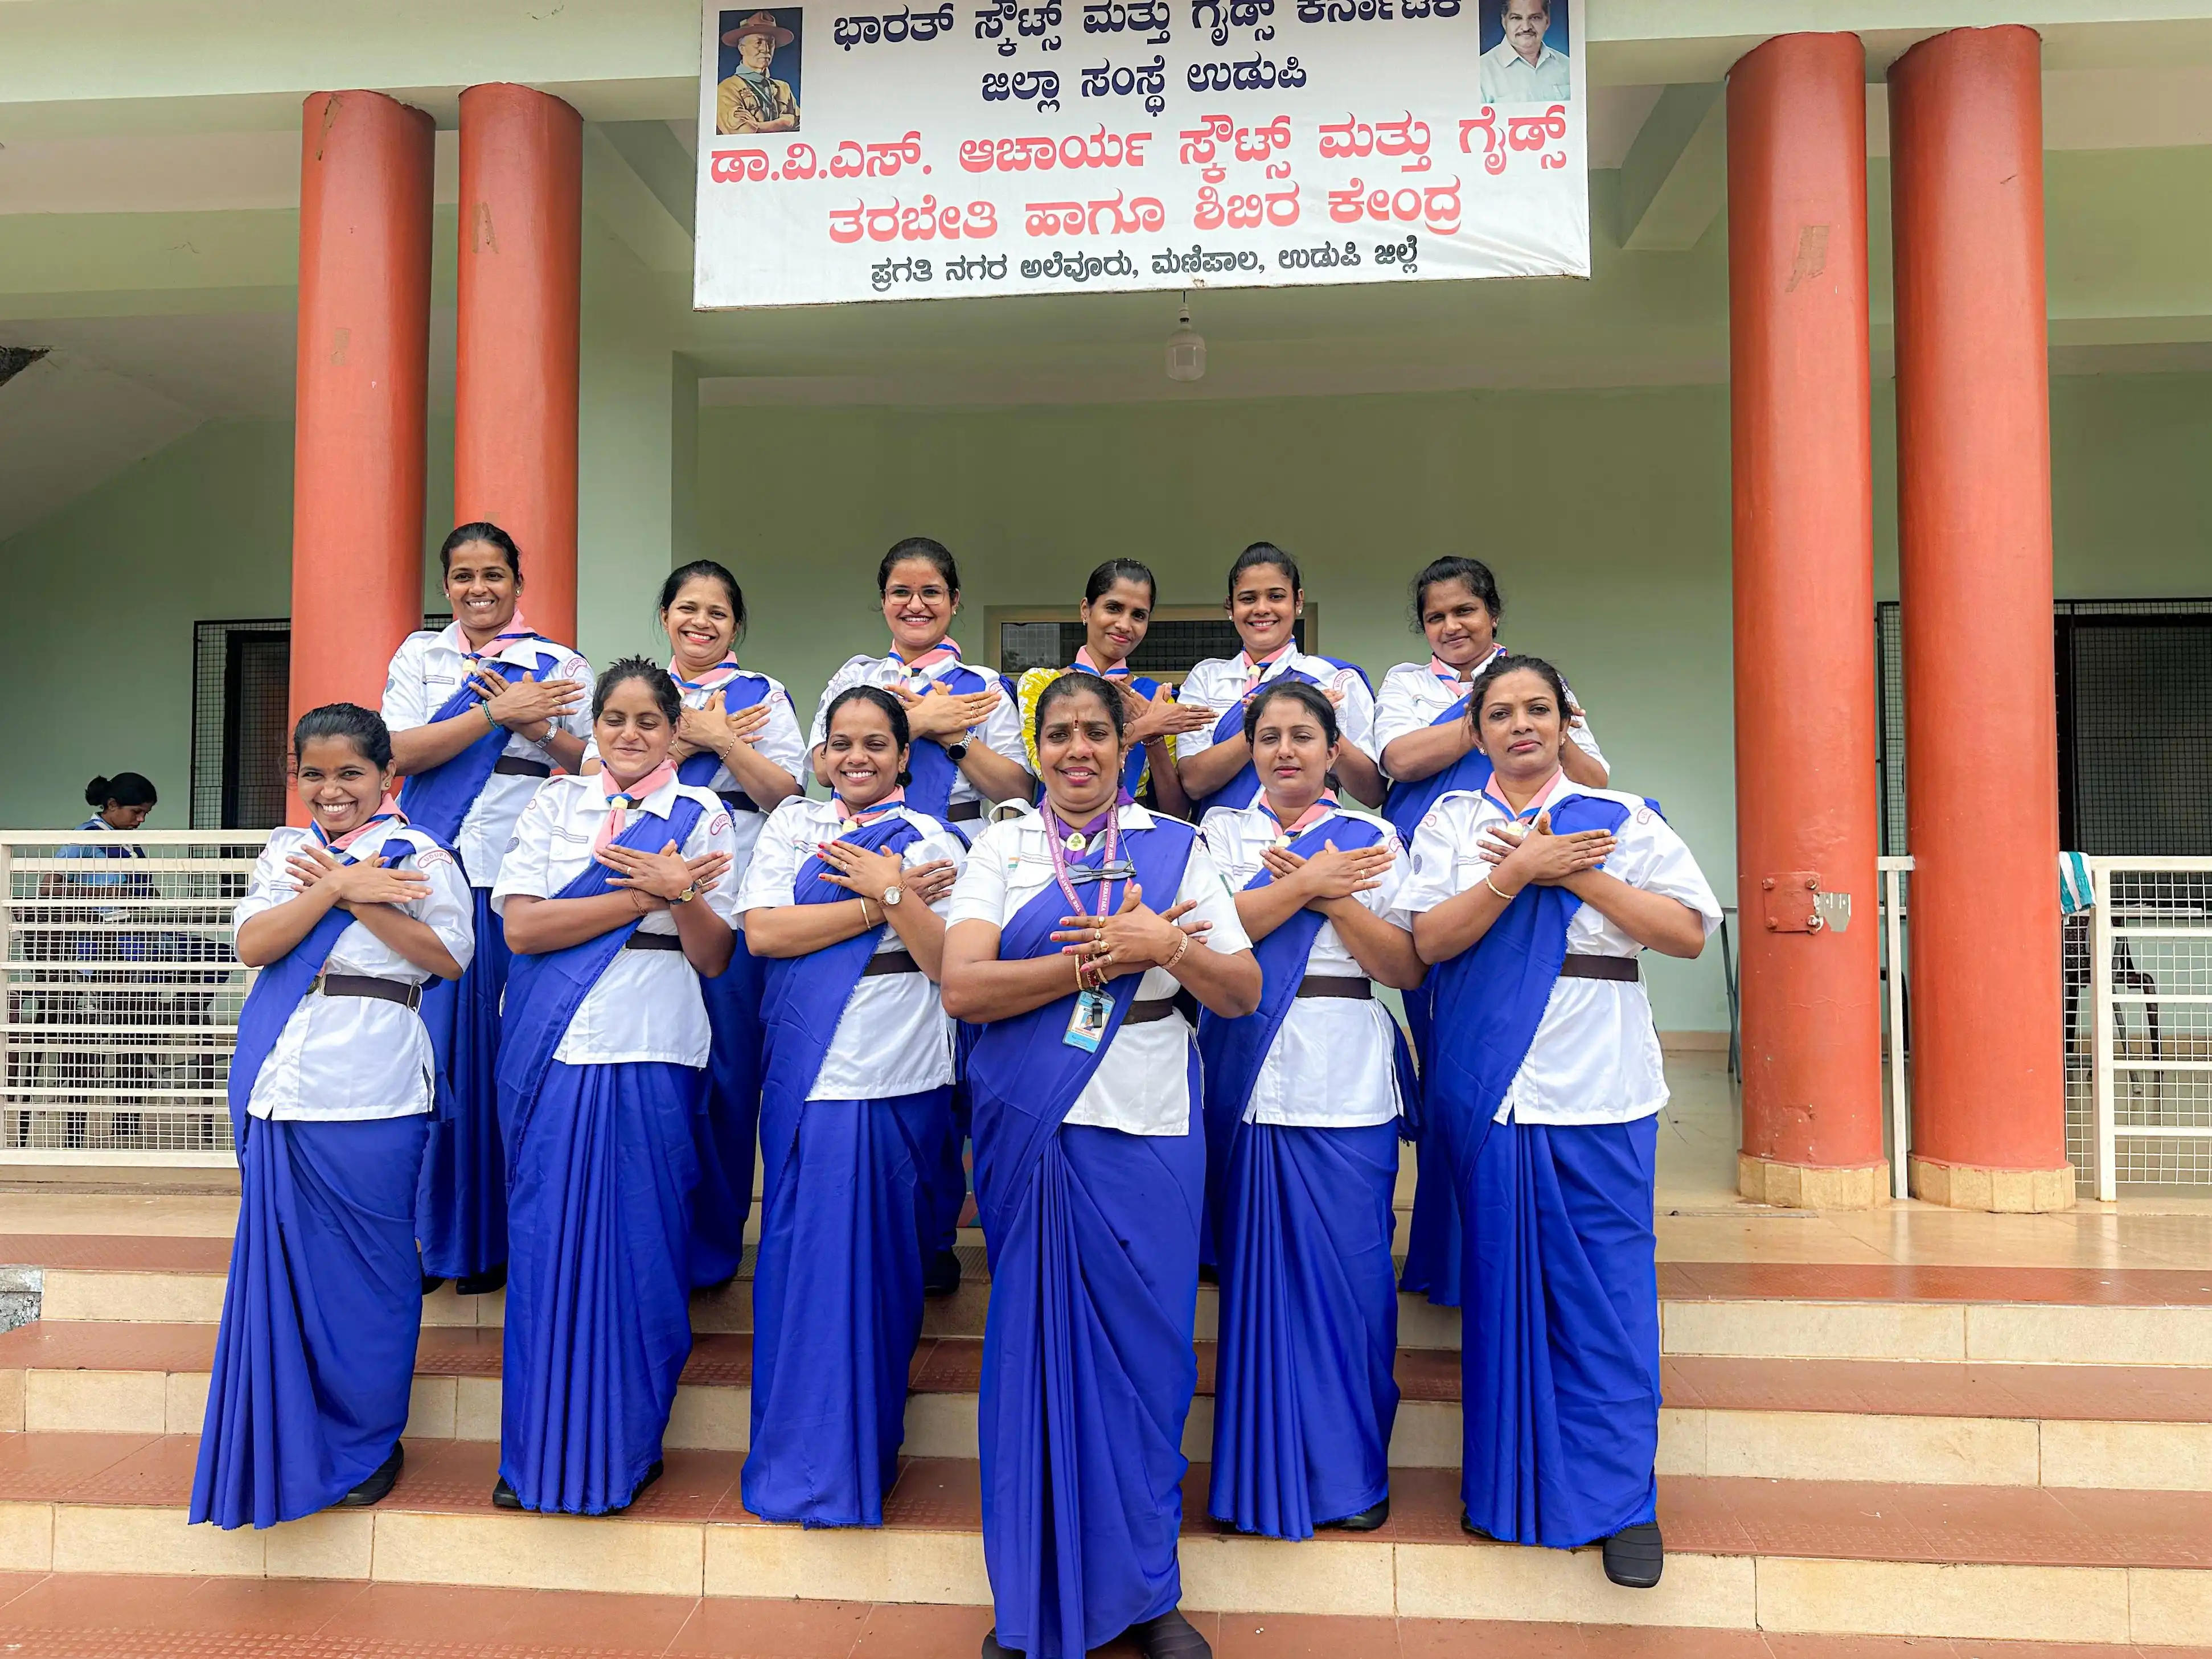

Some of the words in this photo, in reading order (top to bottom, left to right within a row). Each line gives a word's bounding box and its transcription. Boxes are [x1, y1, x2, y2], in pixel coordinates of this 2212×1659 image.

[834, 3, 955, 52] ಭಾರತ್
[1084, 0, 1171, 46] ಮತ್ತು
[982, 69, 1061, 114] ಜಿಲ್ಲಾ
[1082, 55, 1166, 118] ಸಂಸ್ಥೆ
[1188, 51, 1307, 93] ಉಡುಪಿ
[959, 122, 1153, 173] ಆಚಾರ್ಯ
[1319, 110, 1432, 173] ಮತ್ತು
[1459, 105, 1567, 176] ಗೈಡ್ಸ್
[830, 195, 998, 244] ತರಬೇತಿ
[1026, 188, 1165, 237] ಹಾಗೂ
[1195, 180, 1300, 230] ಶಿಬಿರ
[1329, 174, 1461, 236] ಕೇಂದ್ರ
[872, 257, 933, 293] ಪ್ರಗತಿ
[946, 254, 1008, 281] ನಗರ
[1021, 250, 1139, 283] ಅಲೆವೂರು,
[1152, 245, 1265, 274] ಮಣಿಪಾಲ,
[1279, 241, 1361, 269] ಉಡುಪಿ
[1375, 235, 1418, 274] ಜಿಲ್ಲೆ
[423, 852, 446, 861] UDUPI
[1073, 901, 1081, 913] THE
[1101, 881, 1110, 911] KARNATAKA
